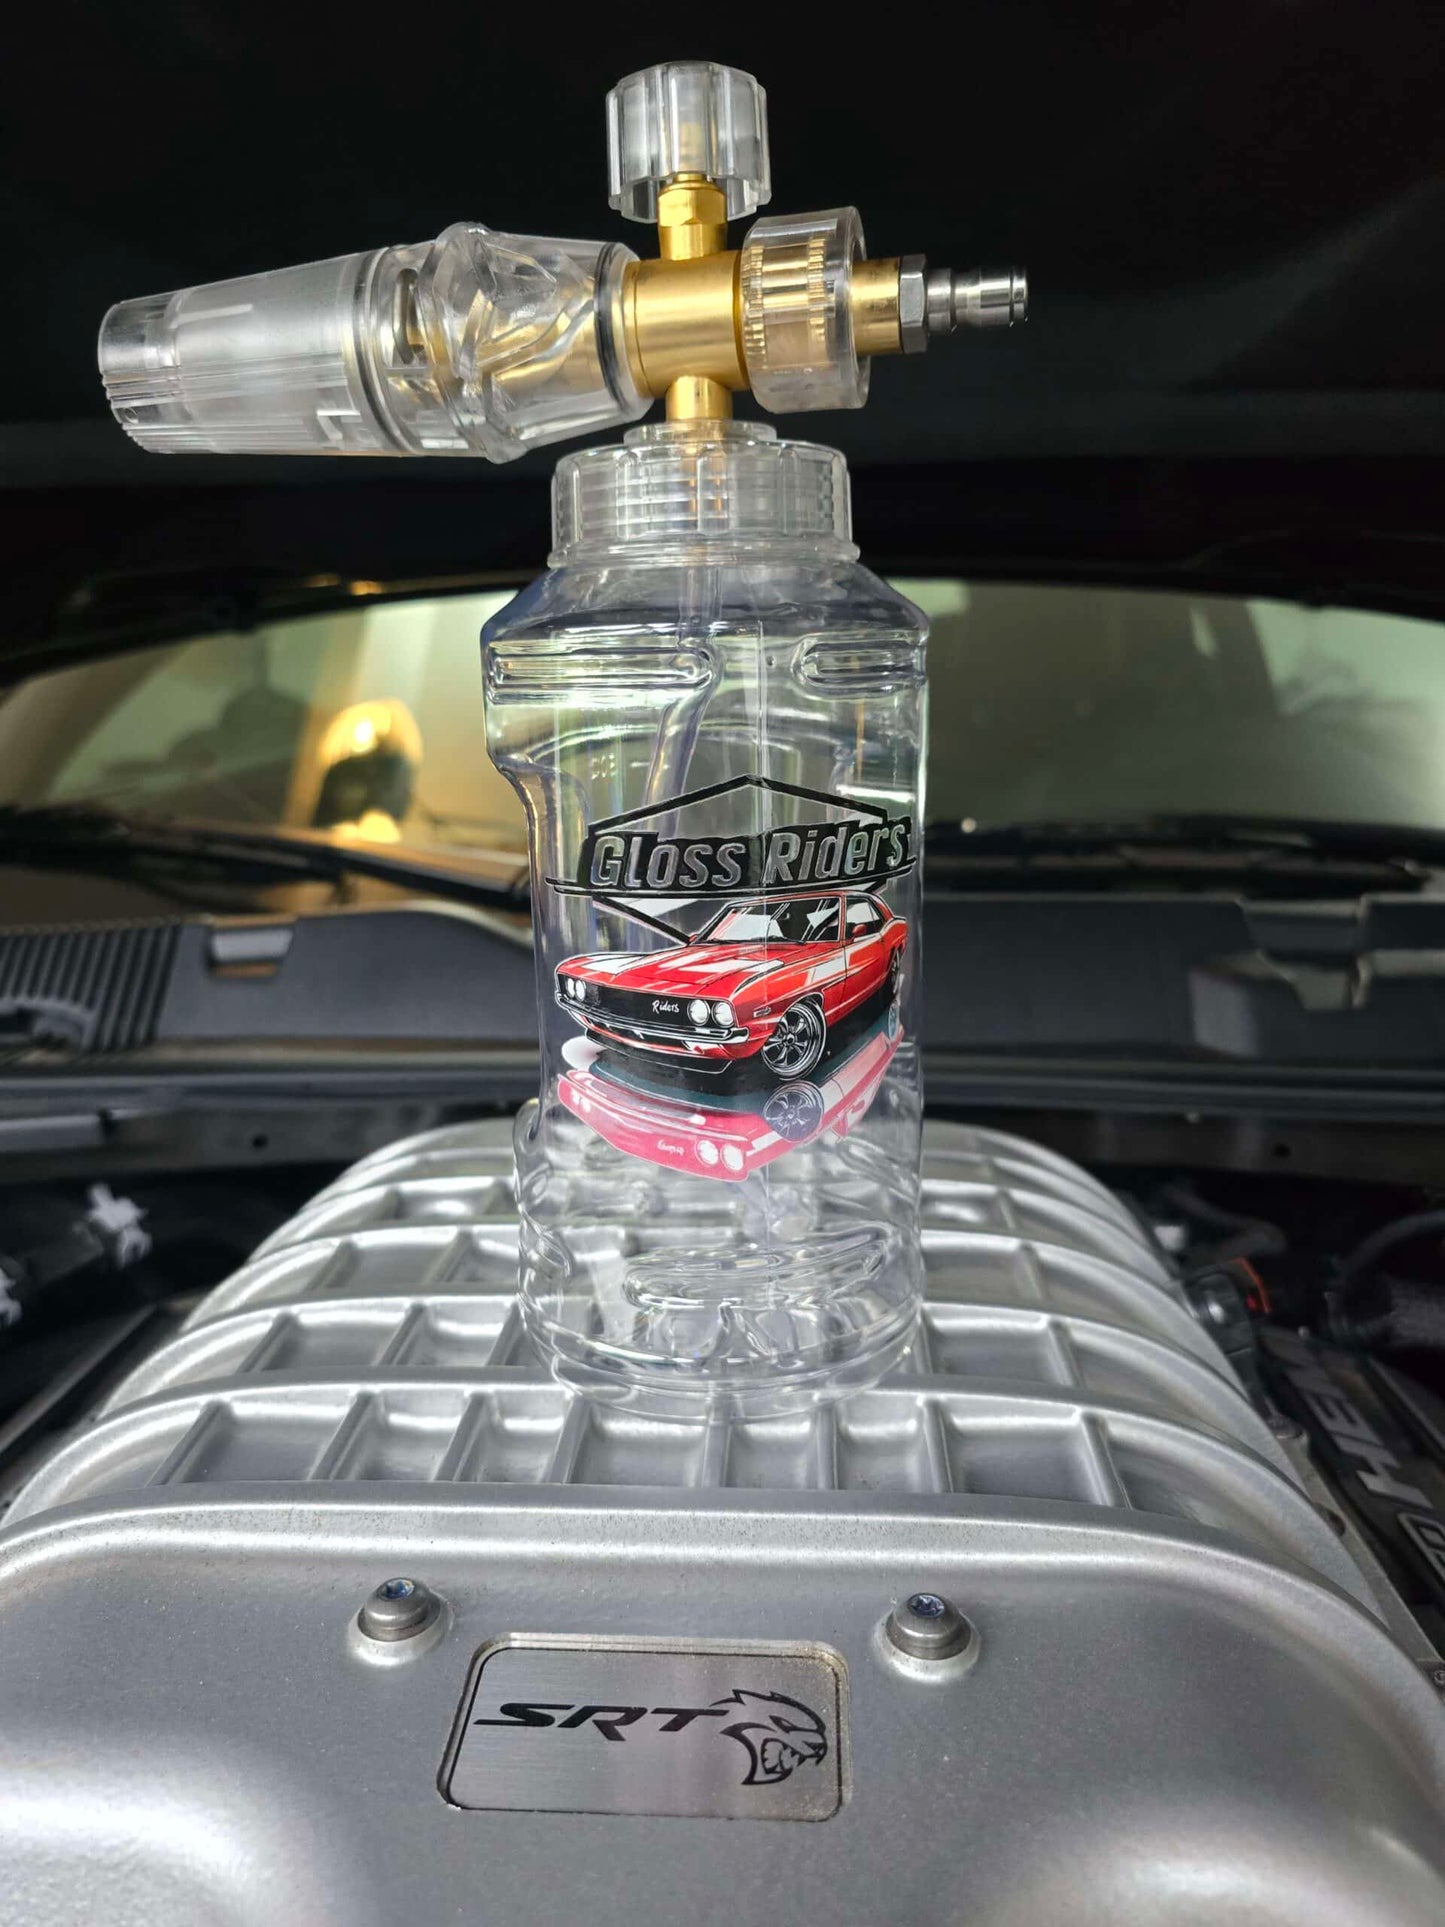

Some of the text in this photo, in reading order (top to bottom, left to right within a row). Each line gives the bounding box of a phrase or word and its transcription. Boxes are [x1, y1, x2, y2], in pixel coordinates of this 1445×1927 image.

[589, 823, 907, 888] Gloss Riders
[652, 1000, 680, 1014] Riders
[473, 1702, 730, 1742] SRT
